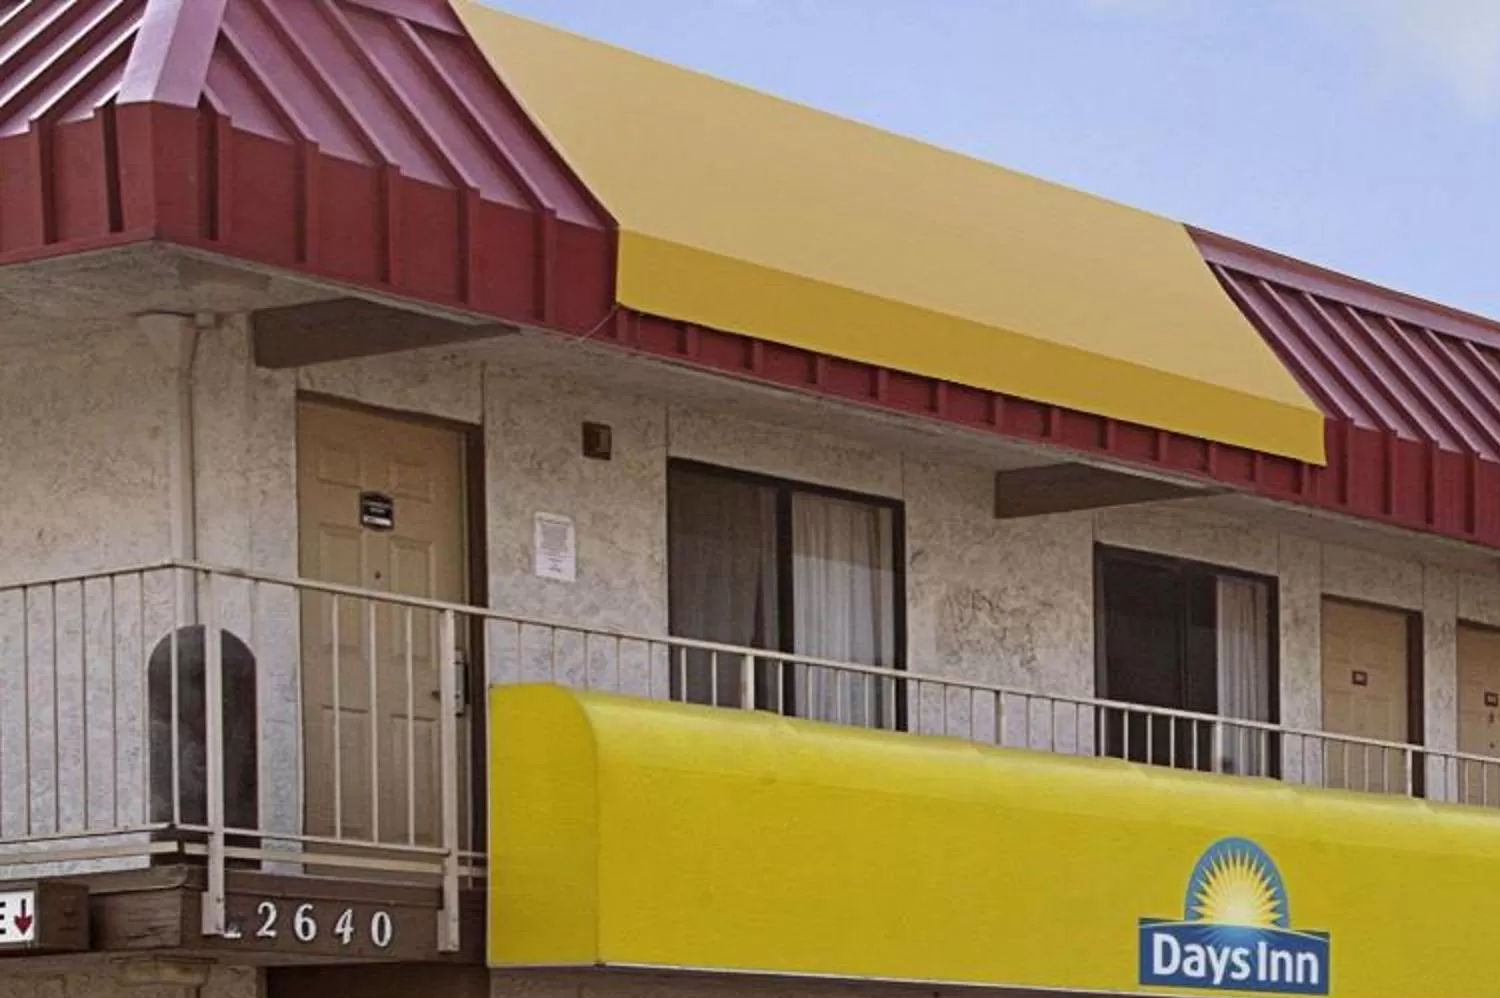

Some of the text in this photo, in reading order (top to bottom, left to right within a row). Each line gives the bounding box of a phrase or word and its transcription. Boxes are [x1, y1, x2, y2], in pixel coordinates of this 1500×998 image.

[256, 901, 393, 947] 2640
[1152, 932, 1319, 986] Days Inn
